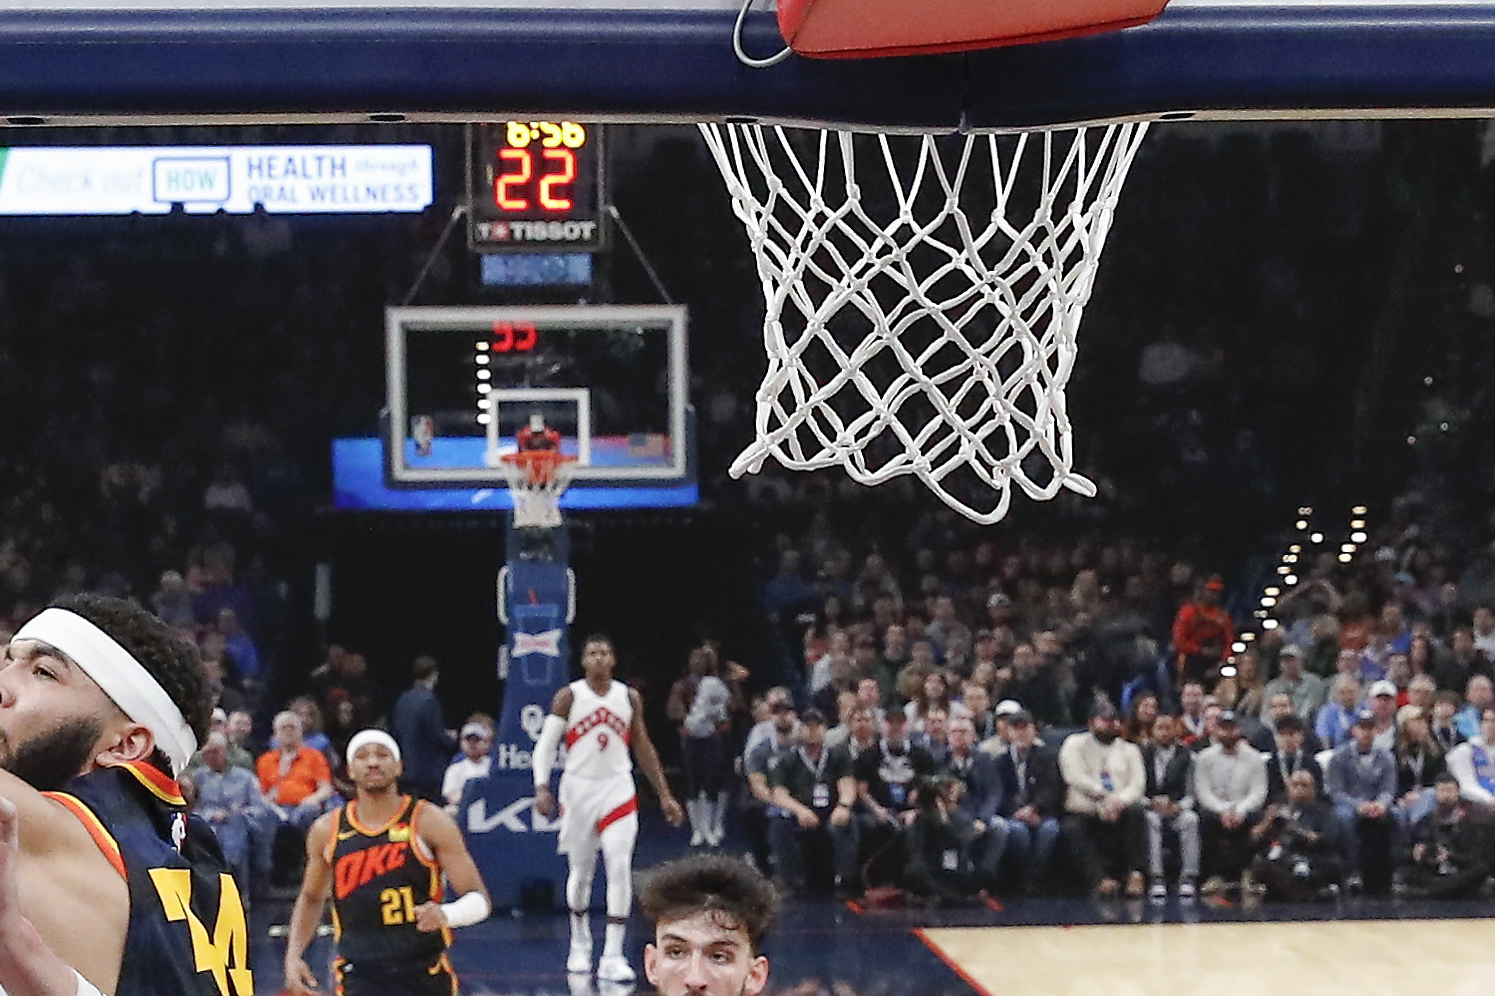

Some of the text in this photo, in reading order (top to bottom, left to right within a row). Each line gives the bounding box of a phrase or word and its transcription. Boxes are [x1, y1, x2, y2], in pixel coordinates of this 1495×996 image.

[247, 155, 348, 180] HEALTH
[166, 169, 217, 191] HOW
[494, 147, 577, 212] 22
[309, 184, 420, 203] WELLNESS
[510, 220, 596, 241] TISSOT
[597, 732, 610, 751] 9
[379, 886, 416, 926] 21
